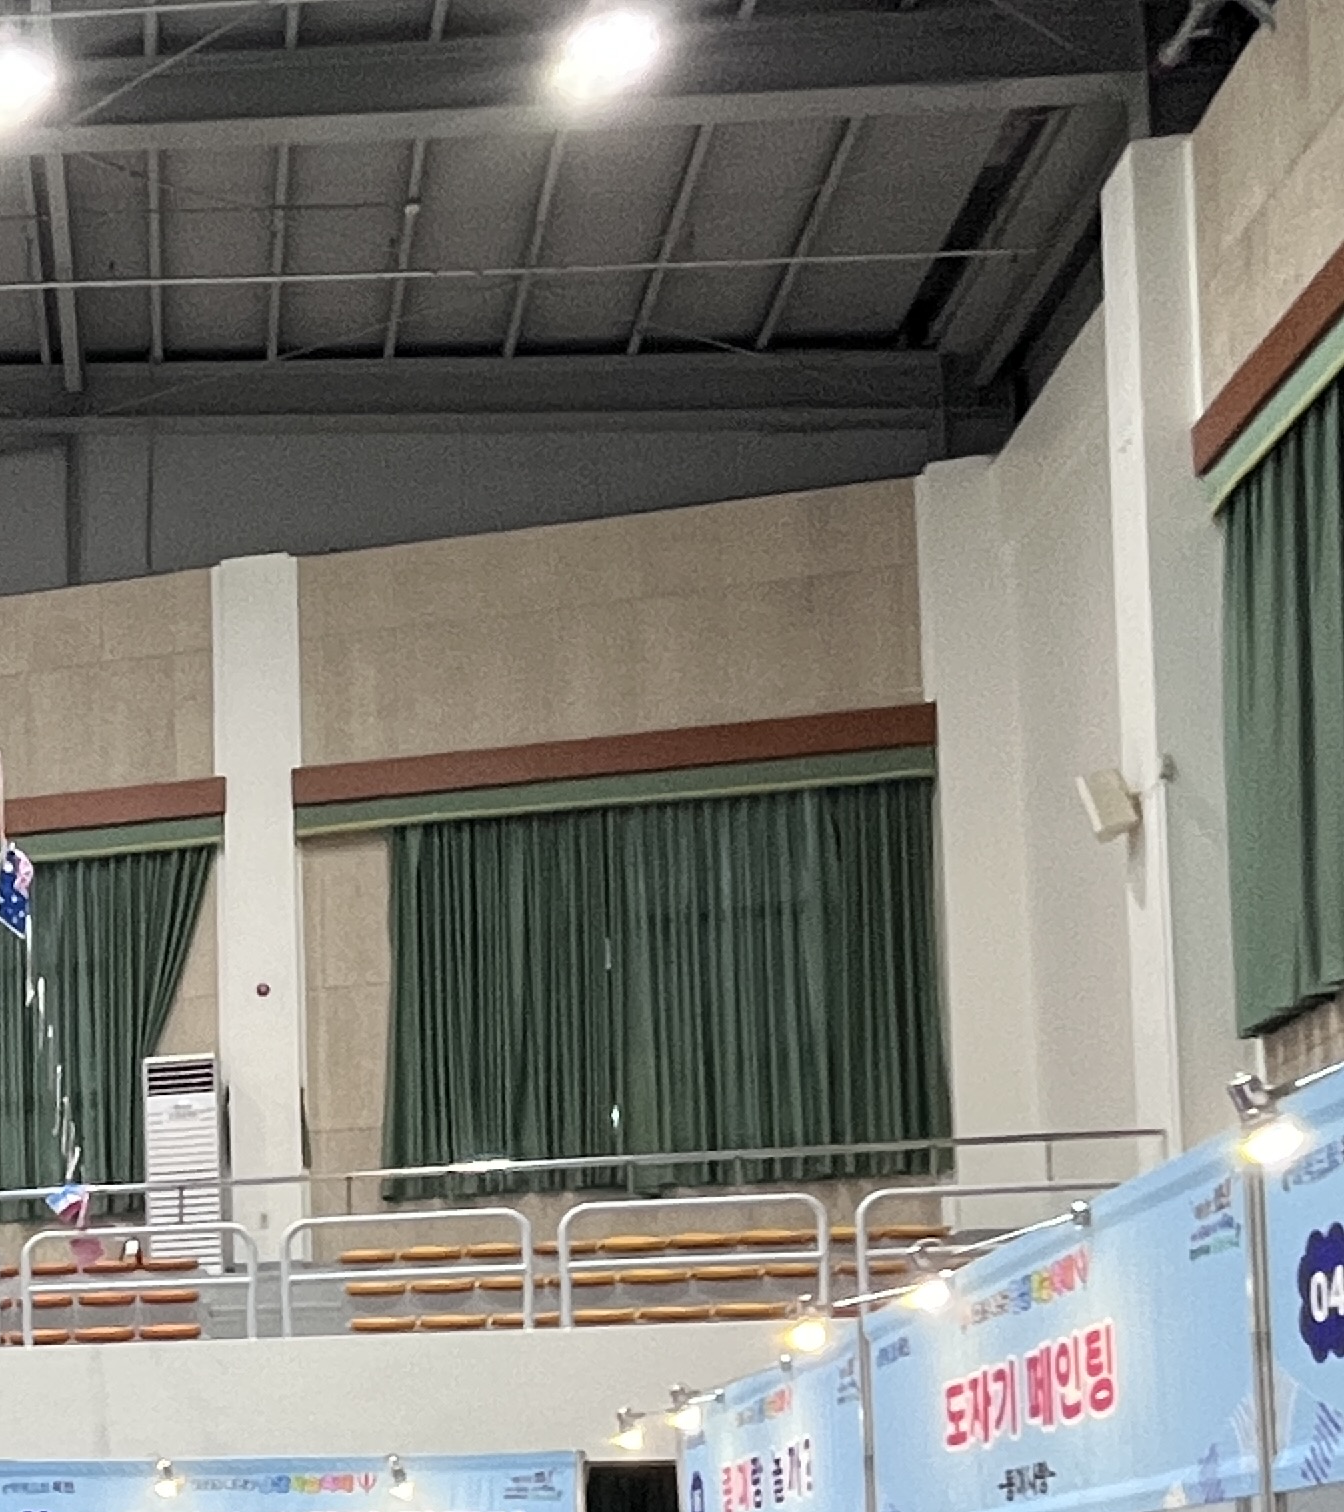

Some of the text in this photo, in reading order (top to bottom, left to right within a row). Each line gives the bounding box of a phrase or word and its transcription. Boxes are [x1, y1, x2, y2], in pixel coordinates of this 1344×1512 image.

[1309, 1265, 1344, 1323] 04
[945, 1359, 1017, 1447] 도자기
[1026, 1324, 1114, 1426] 페인팅
